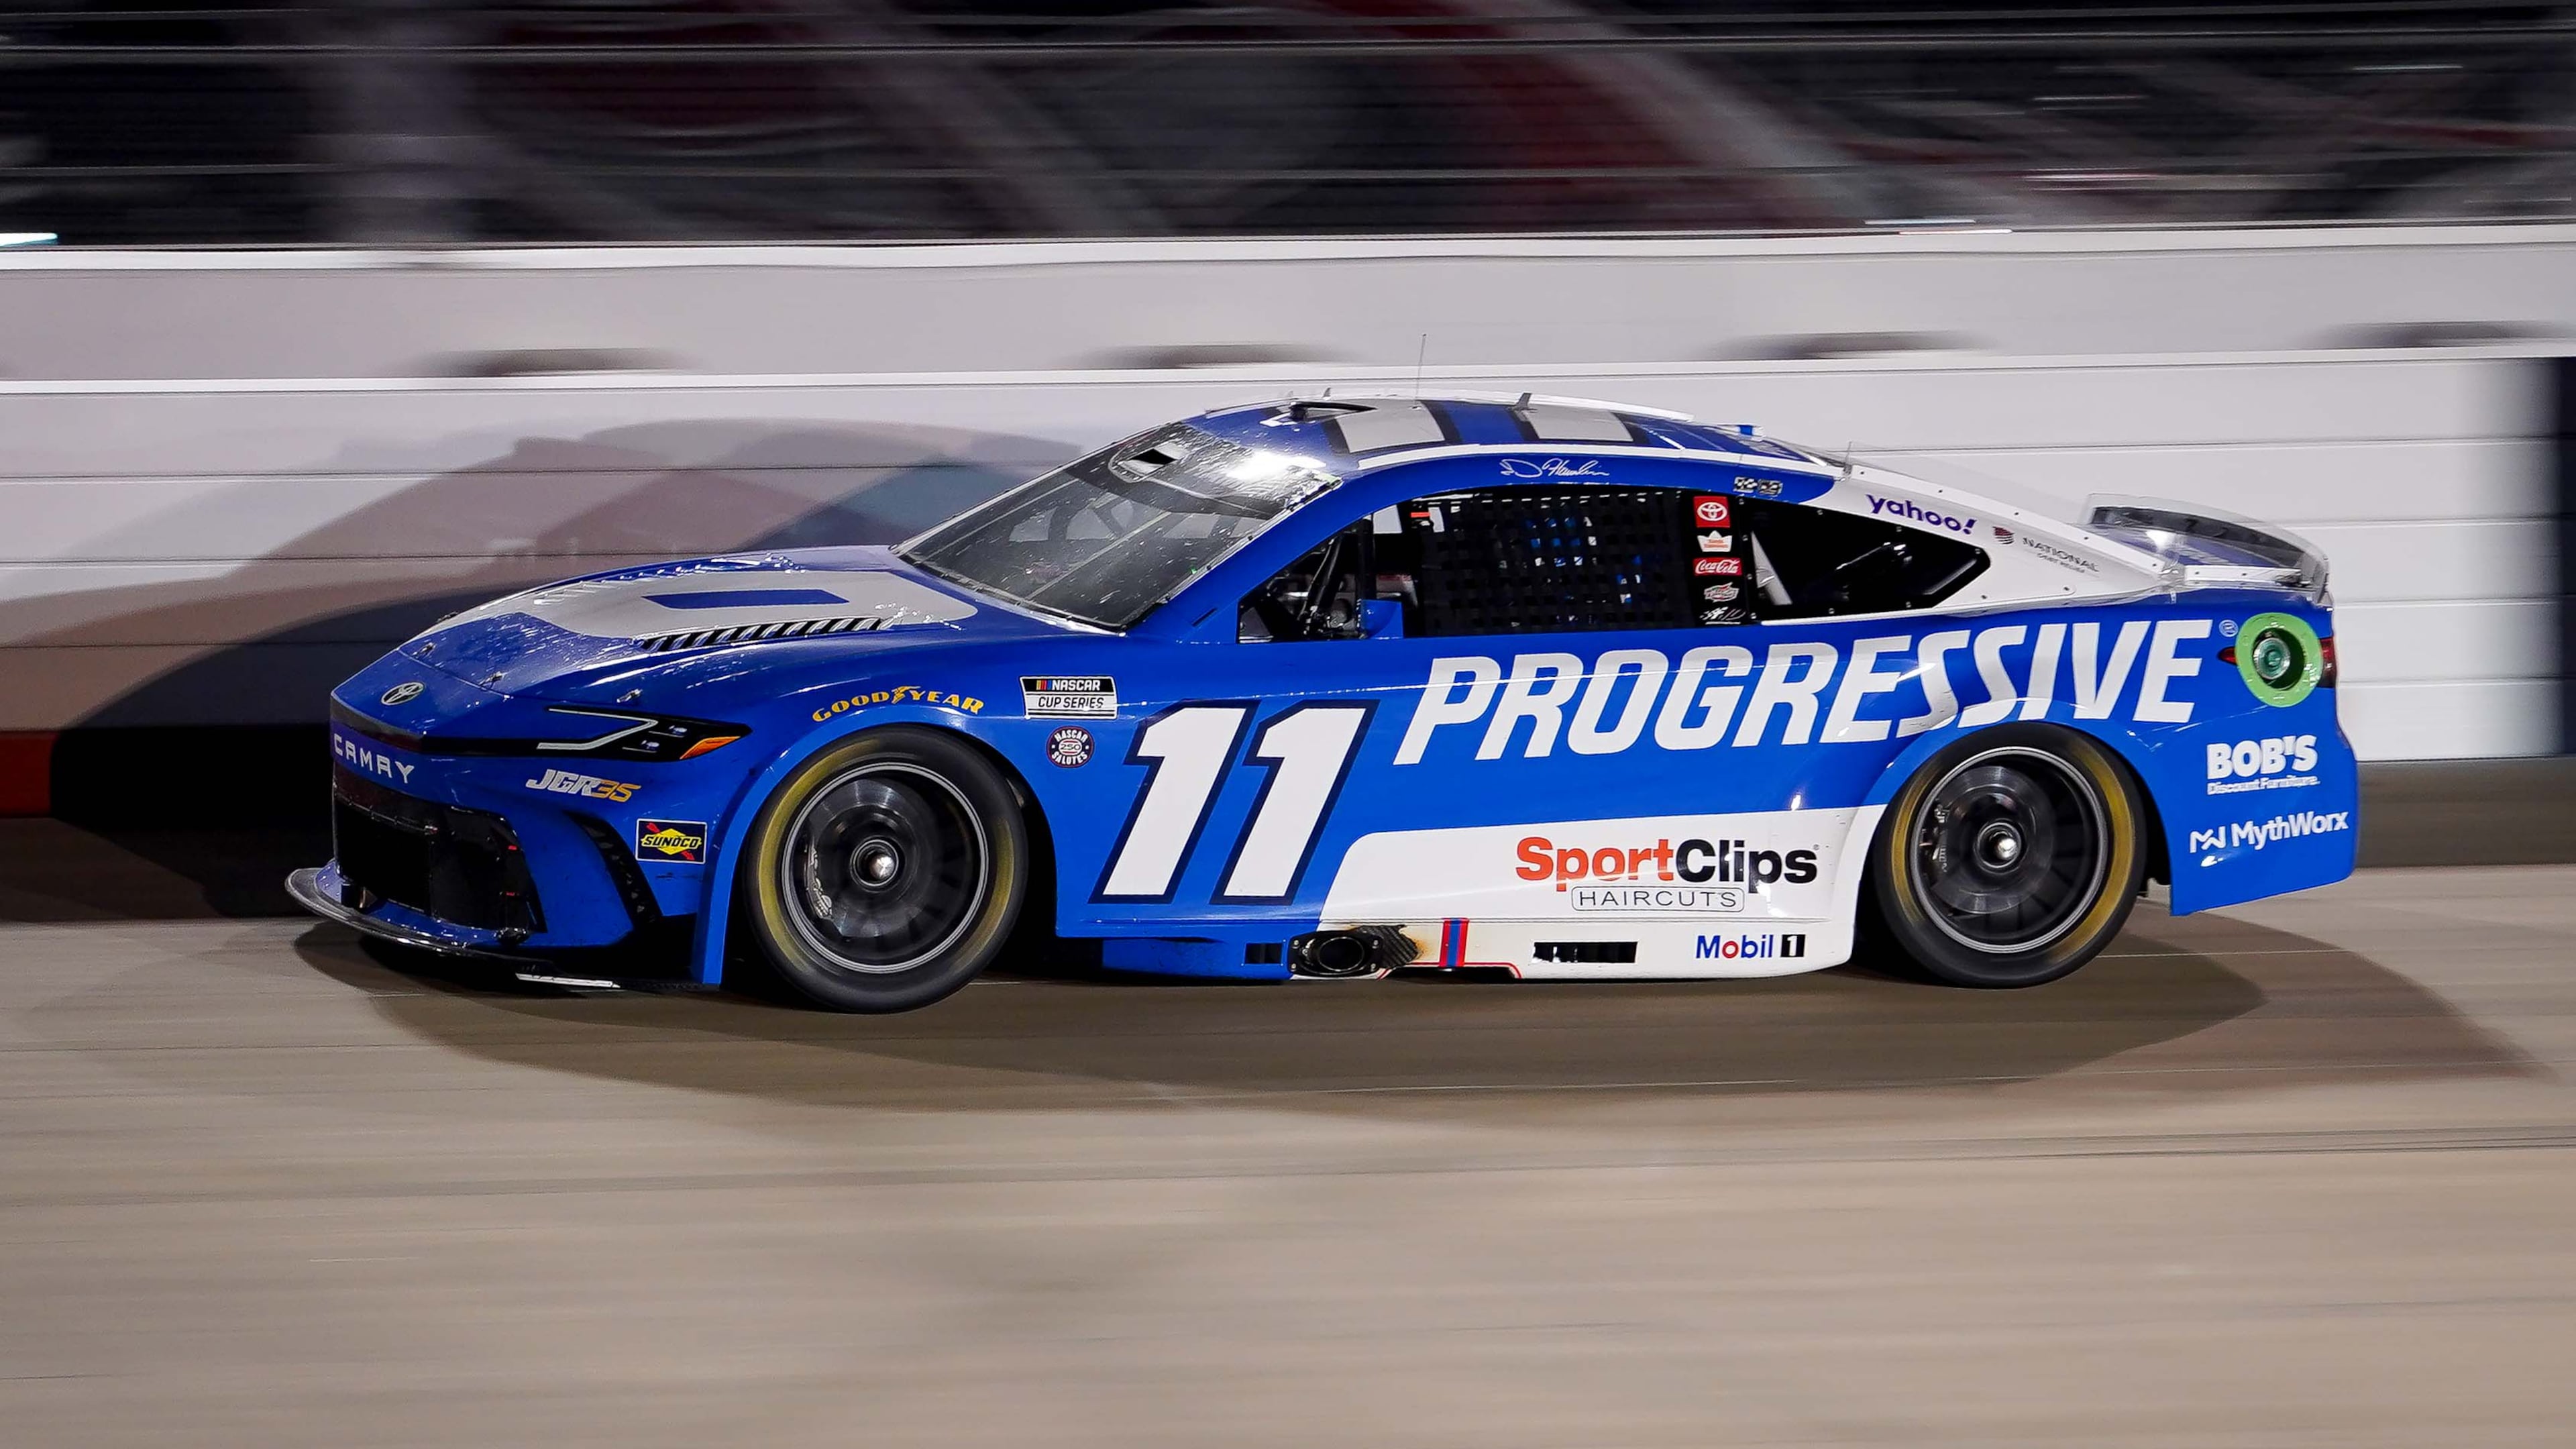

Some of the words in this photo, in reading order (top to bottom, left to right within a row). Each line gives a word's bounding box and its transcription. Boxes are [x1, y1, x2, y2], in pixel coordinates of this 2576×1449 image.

[1866, 494, 1977, 535] yahoo!
[1051, 679, 1102, 692] NASCAR
[1394, 619, 2213, 766] PROGRESSIVE
[1038, 696, 1062, 708] CUP
[1063, 696, 1105, 709] SERIES
[1054, 729, 1089, 743] NASCAR
[333, 734, 415, 784] CAMRY
[1051, 751, 1088, 765] SALUTES
[2207, 735, 2318, 780] BOB'S
[525, 769, 642, 802] JGR35
[1093, 702, 1377, 904] 11
[642, 834, 701, 849] SUNOCO
[2231, 811, 2349, 851] MythWorx
[1578, 890, 1737, 908] HAIRCUTS
[1695, 934, 1774, 959] Mobil
